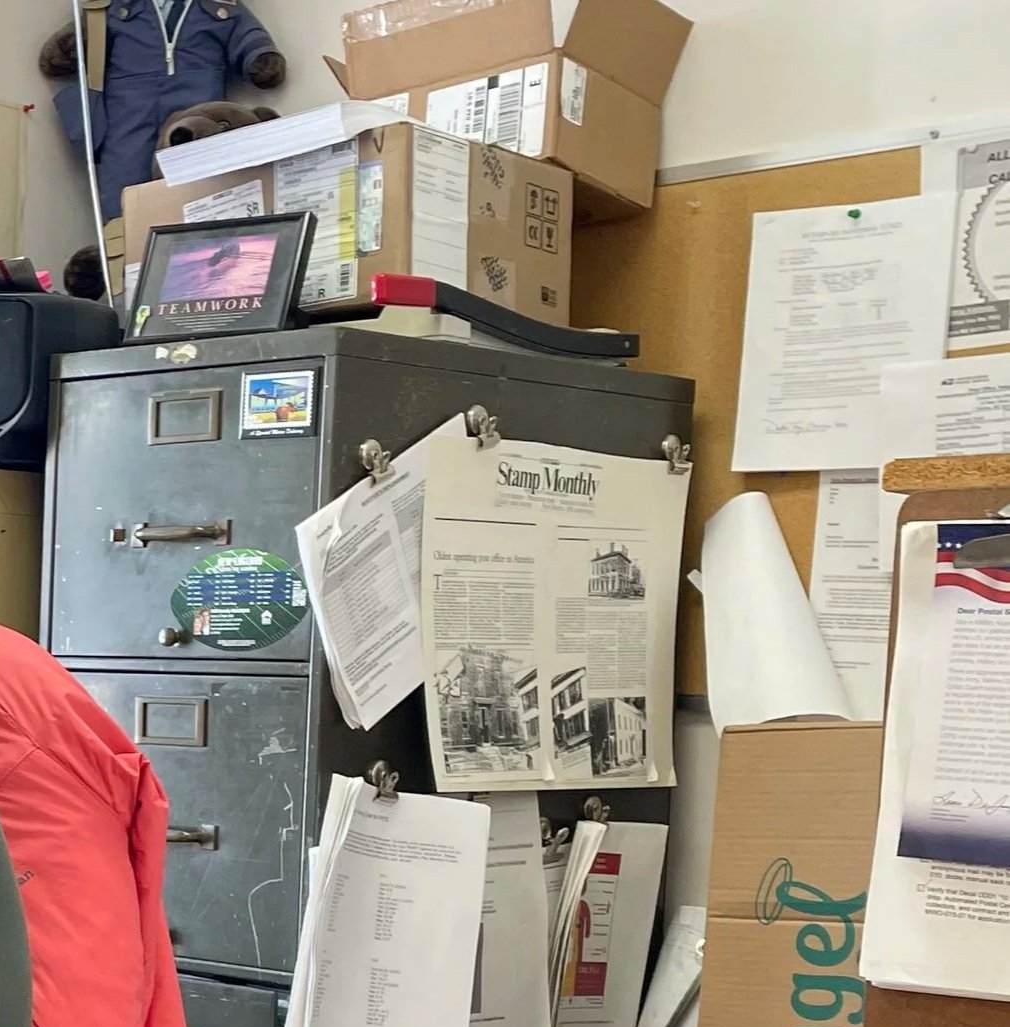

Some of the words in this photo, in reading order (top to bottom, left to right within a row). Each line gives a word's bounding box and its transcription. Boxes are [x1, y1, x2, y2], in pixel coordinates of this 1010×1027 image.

[318, 288, 326, 298] R
[158, 297, 262, 315] TEAMWORK
[497, 461, 540, 494] Stamp
[542, 466, 599, 501] Monthly
[977, 607, 1003, 615] Postal
